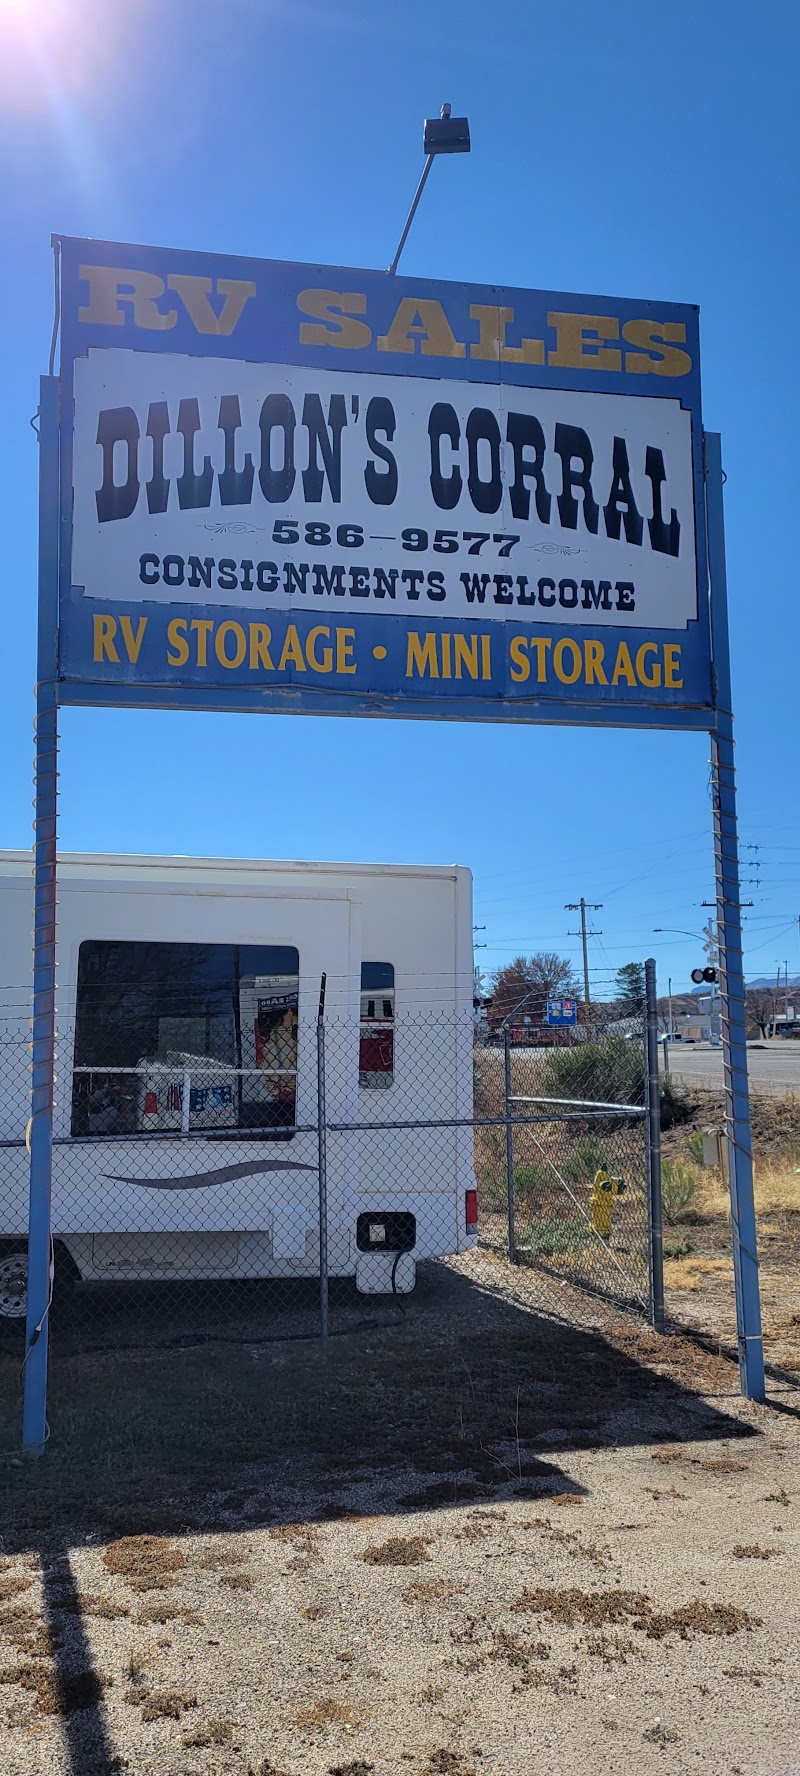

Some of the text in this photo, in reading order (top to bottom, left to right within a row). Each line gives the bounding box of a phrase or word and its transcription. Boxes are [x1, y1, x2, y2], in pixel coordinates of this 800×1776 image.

[78, 265, 692, 376] RV SALES
[95, 393, 681, 558] DILLON'S CORRAL
[272, 519, 521, 558] 586-9577
[139, 553, 636, 611] CONSIGNMENTS WELCOME
[92, 614, 684, 689] RV STORAGE MINI STORAGE
